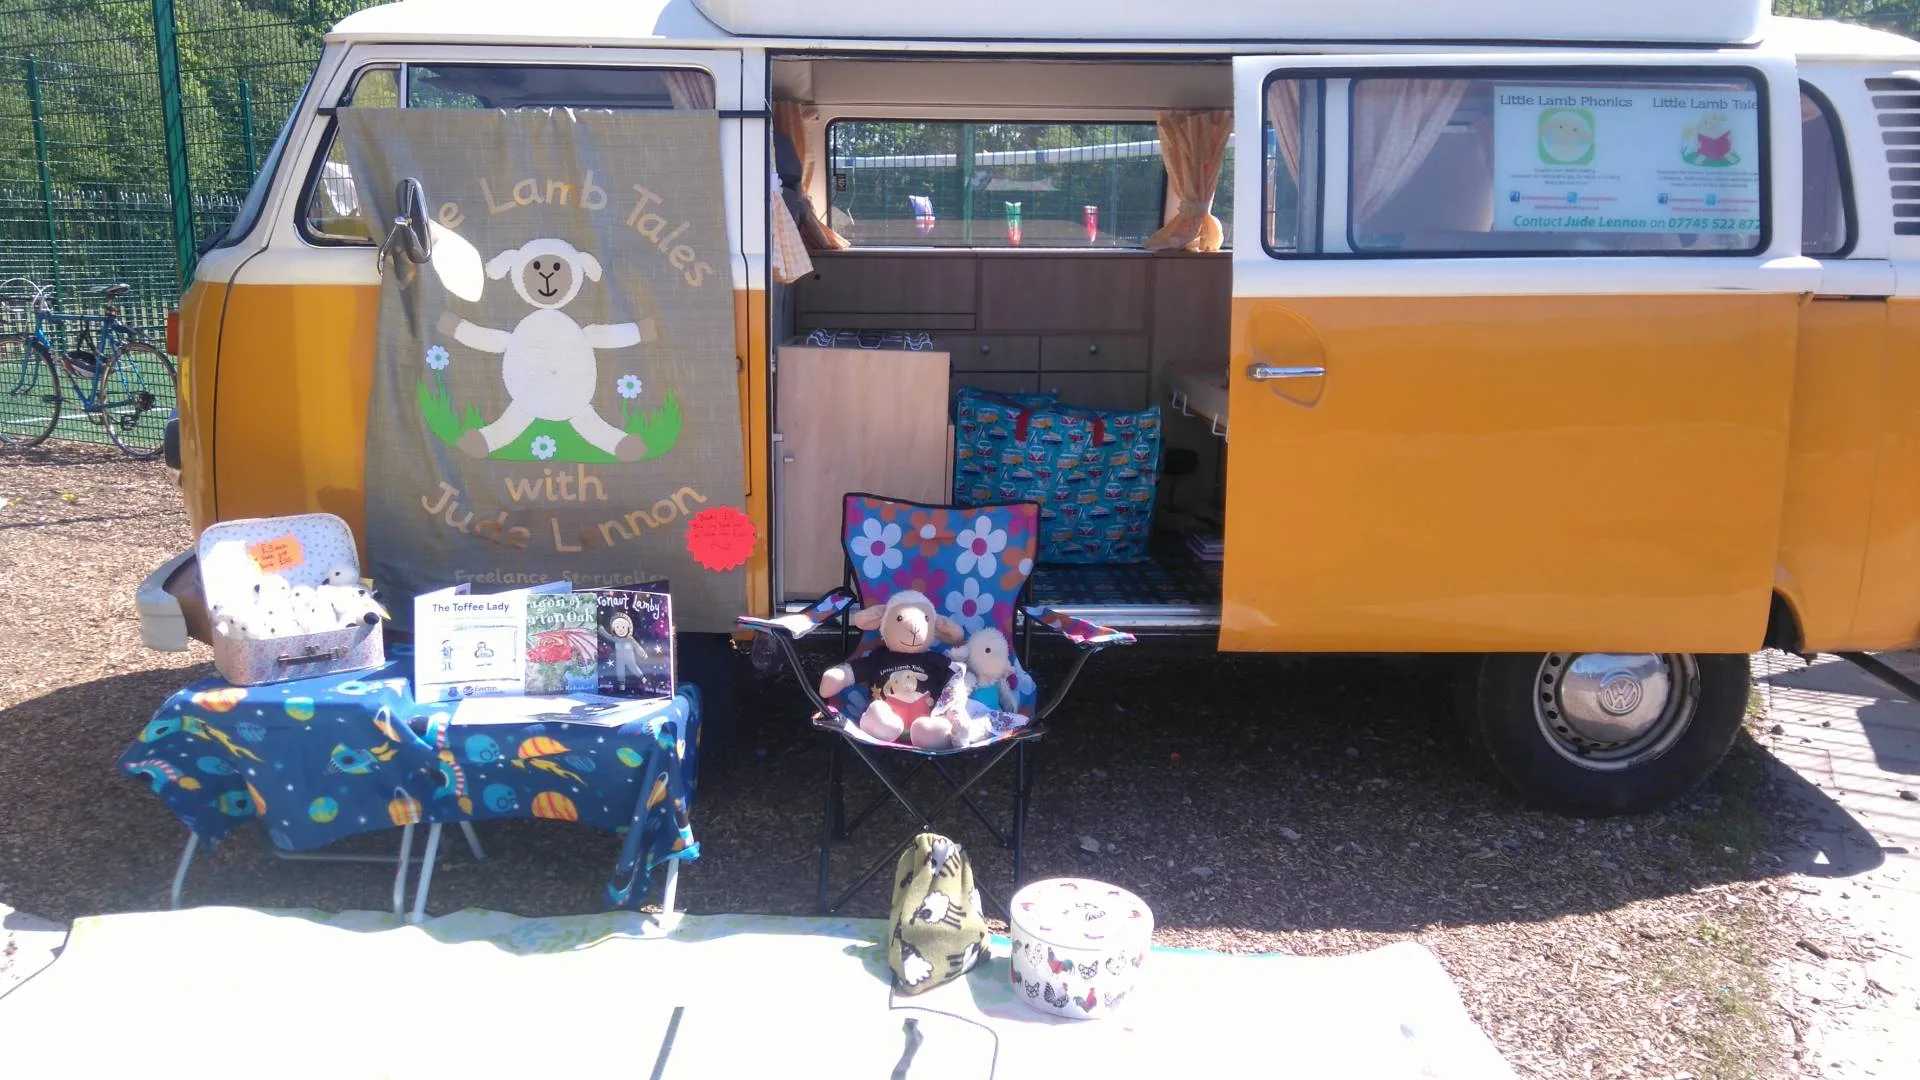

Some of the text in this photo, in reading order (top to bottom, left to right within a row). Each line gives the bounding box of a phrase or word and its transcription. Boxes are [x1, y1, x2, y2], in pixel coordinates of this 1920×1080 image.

[1500, 95, 1633, 108] Little Lamb Phonics
[1653, 97, 1758, 110] Little Lamb Tale
[479, 170, 717, 287] Lamb Tales
[1513, 215, 1562, 228] Contact
[1563, 215, 1597, 228] Jude
[1599, 216, 1648, 229] Lennon
[1650, 219, 1666, 229] on
[1668, 217, 1709, 229] 07745
[1711, 218, 1736, 229] 522
[504, 464, 608, 501] with
[421, 481, 532, 550] Jude
[551, 485, 708, 553] Lennon
[454, 569, 549, 585] Freelance
[432, 602, 510, 613] The Toffee Lady
[528, 597, 565, 614] agon
[597, 594, 661, 620] ronaut Lamby
[566, 608, 594, 623] Oak
